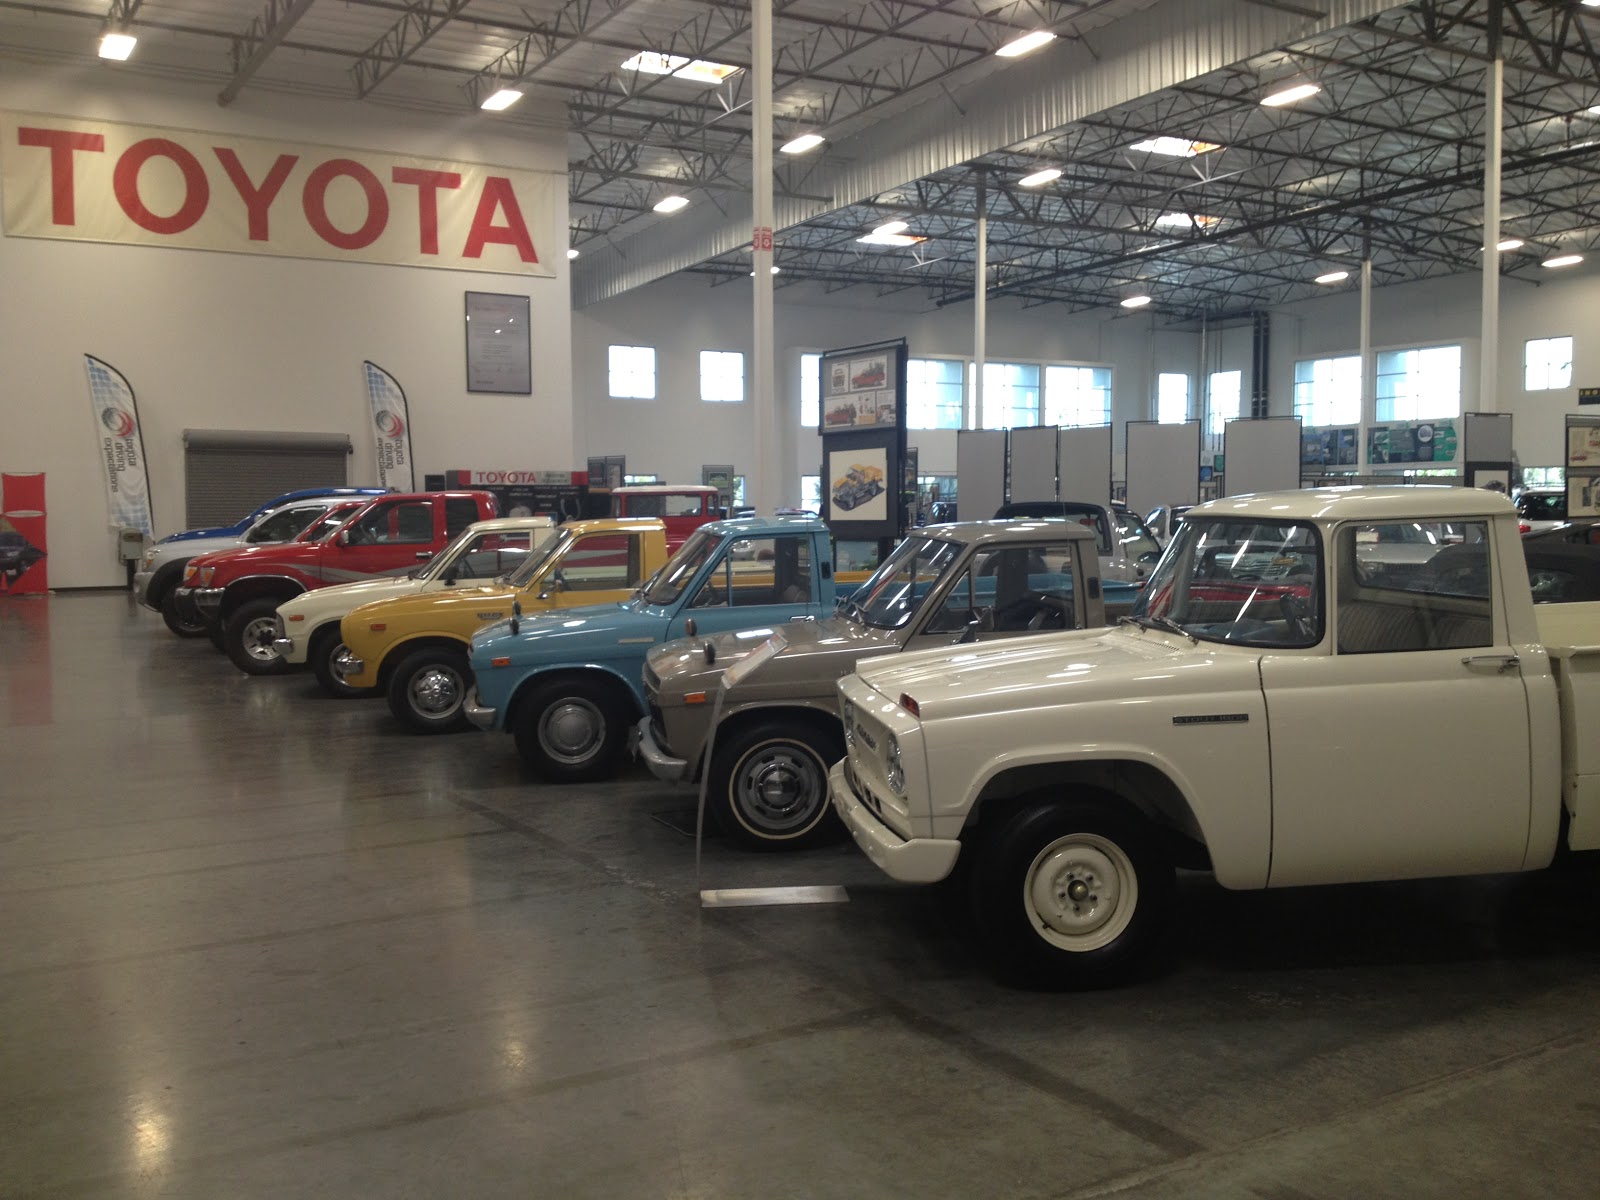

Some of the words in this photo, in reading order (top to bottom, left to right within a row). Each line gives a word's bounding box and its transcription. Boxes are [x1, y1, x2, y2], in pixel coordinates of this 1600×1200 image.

[18, 127, 538, 263] TOYOTA
[115, 442, 126, 472] driving
[125, 438, 137, 466] toyota
[384, 442, 394, 470] driving
[394, 439, 404, 465] toyota
[476, 471, 537, 484] TOYOTA
